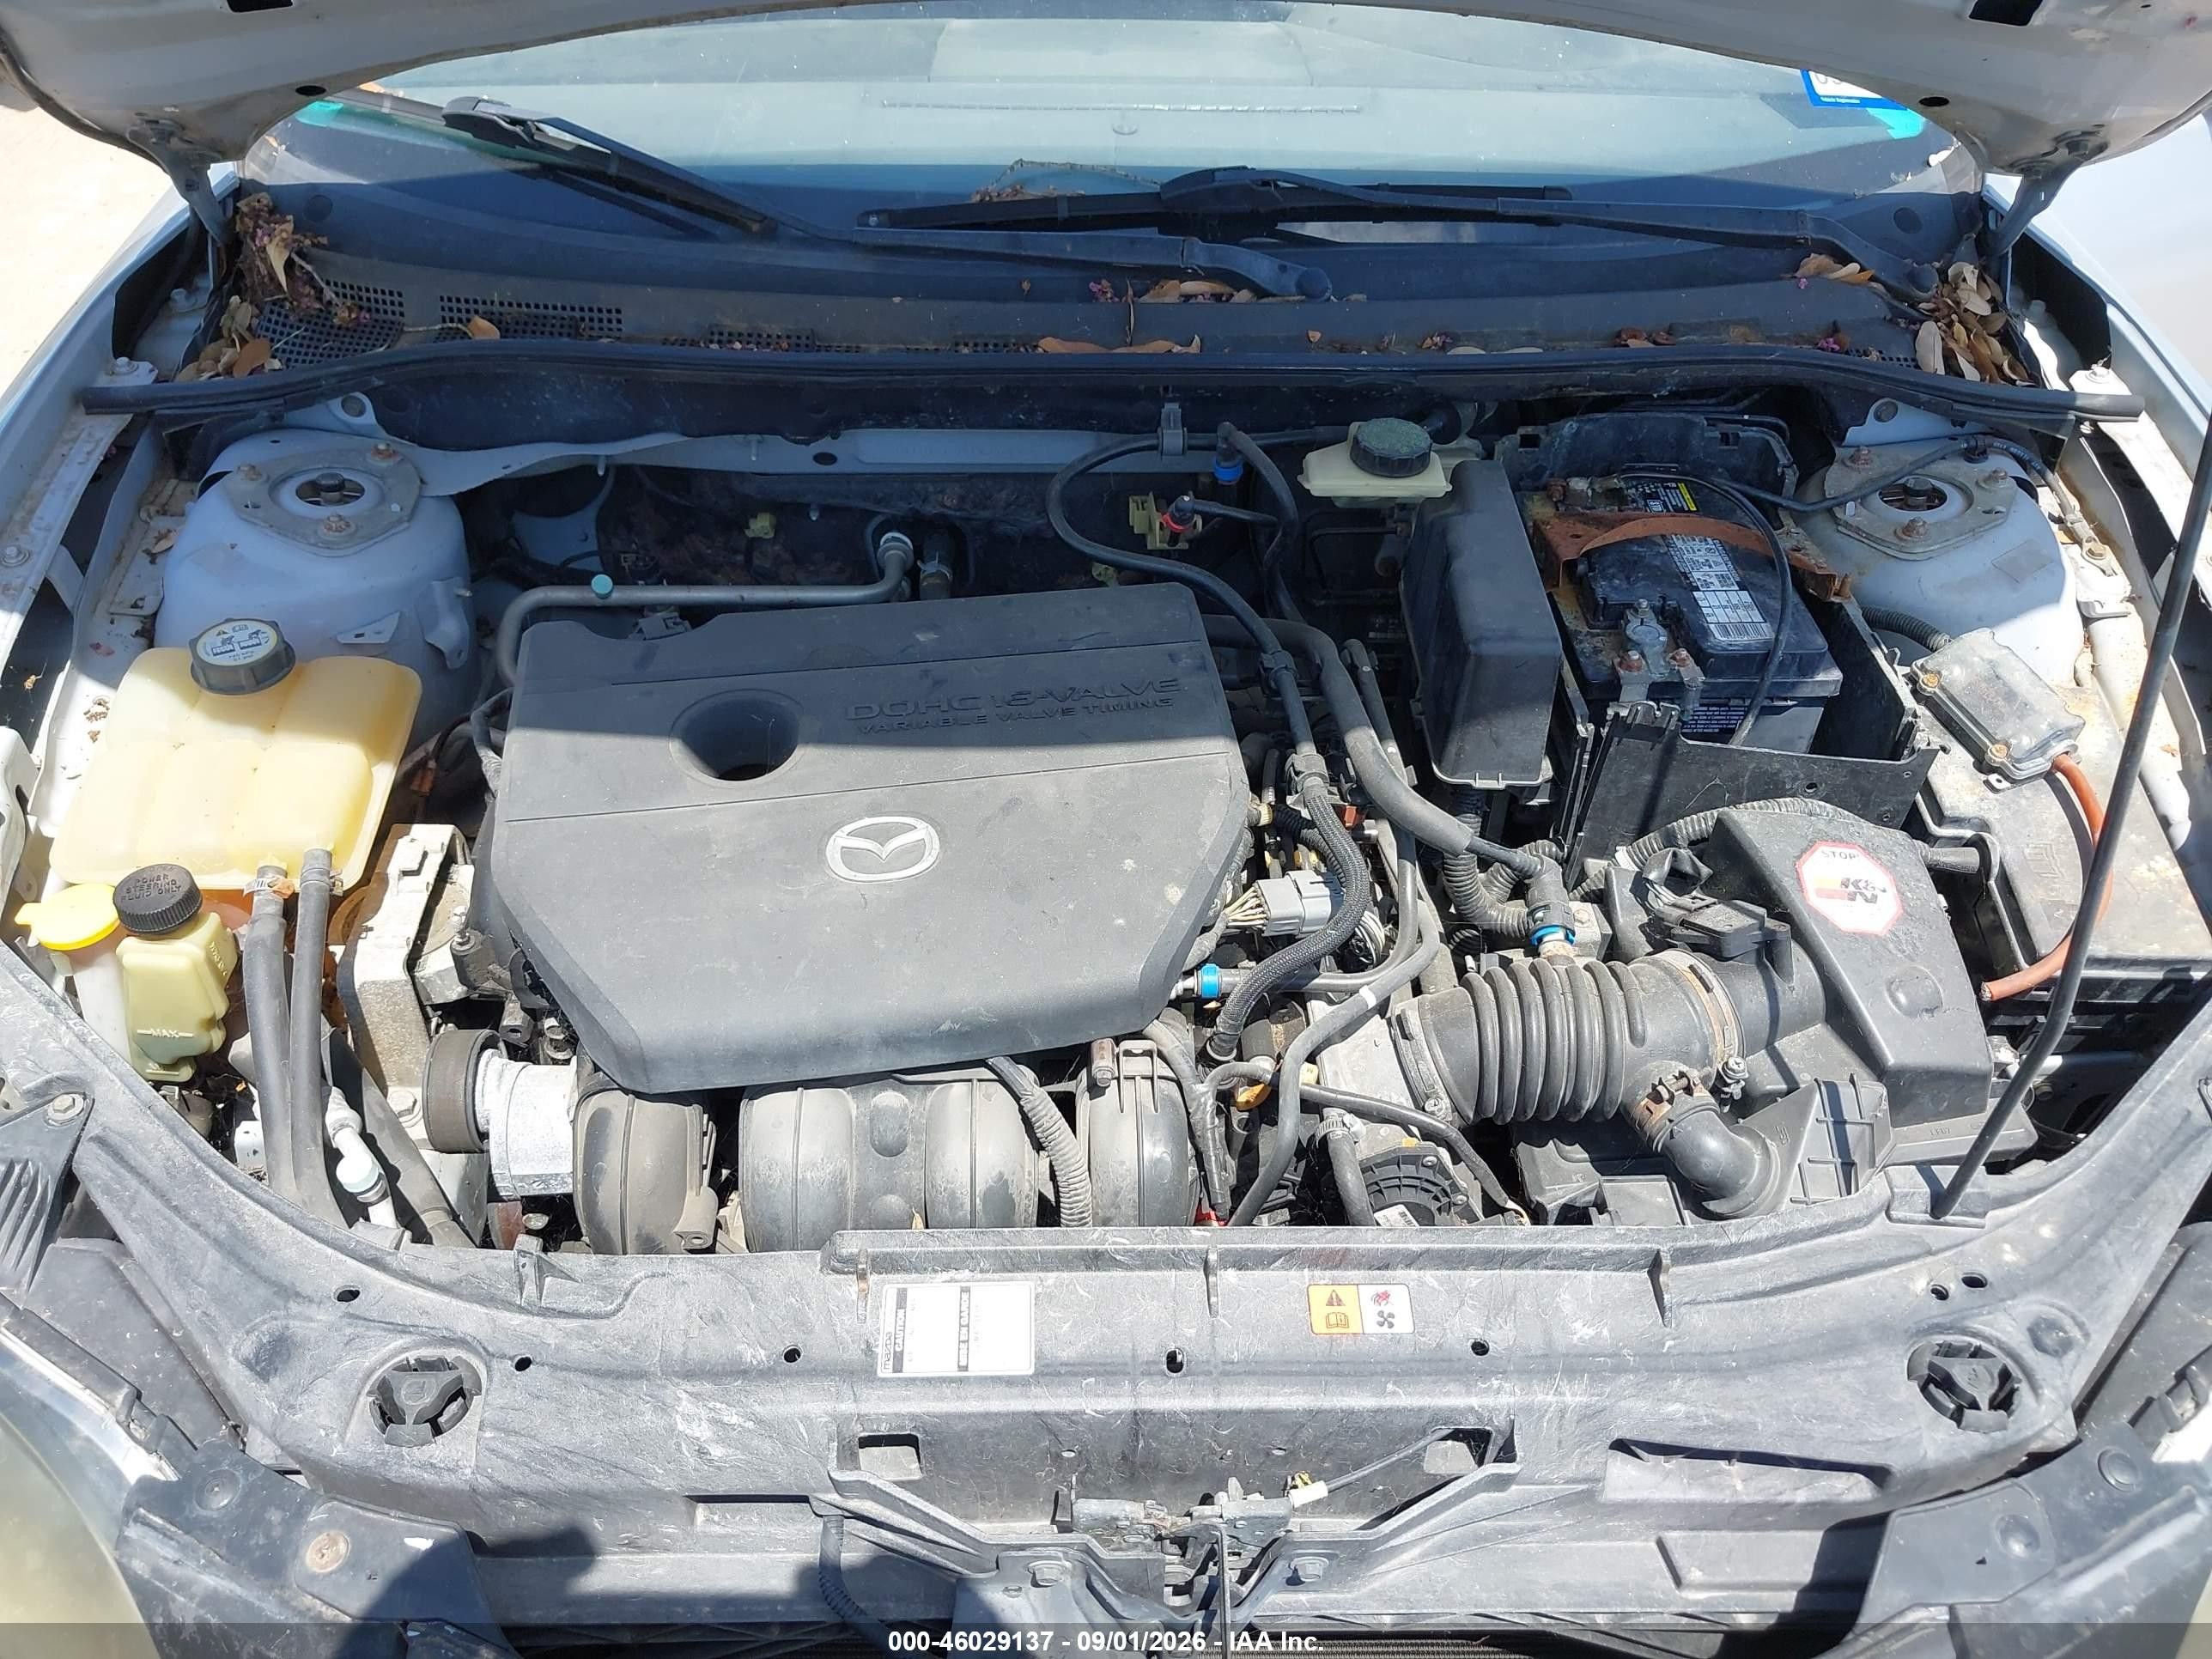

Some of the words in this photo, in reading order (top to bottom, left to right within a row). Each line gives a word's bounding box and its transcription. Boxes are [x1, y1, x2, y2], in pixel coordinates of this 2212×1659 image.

[846, 694, 982, 720] DOHC
[989, 678, 1181, 708] 16-VALVE
[858, 714, 989, 735] VARIABLE
[997, 707, 1077, 723] VALVE
[1083, 697, 1175, 714] TIMING
[125, 878, 177, 894] STEERING
[135, 873, 170, 885] POWER
[120, 890, 152, 903] FLUID
[157, 884, 182, 895] ONLY
[150, 1028, 179, 1038] MAX
[960, 1291, 970, 1325] GARDE
[895, 1308, 906, 1352] CAUTION
[959, 1327, 969, 1340] EN
